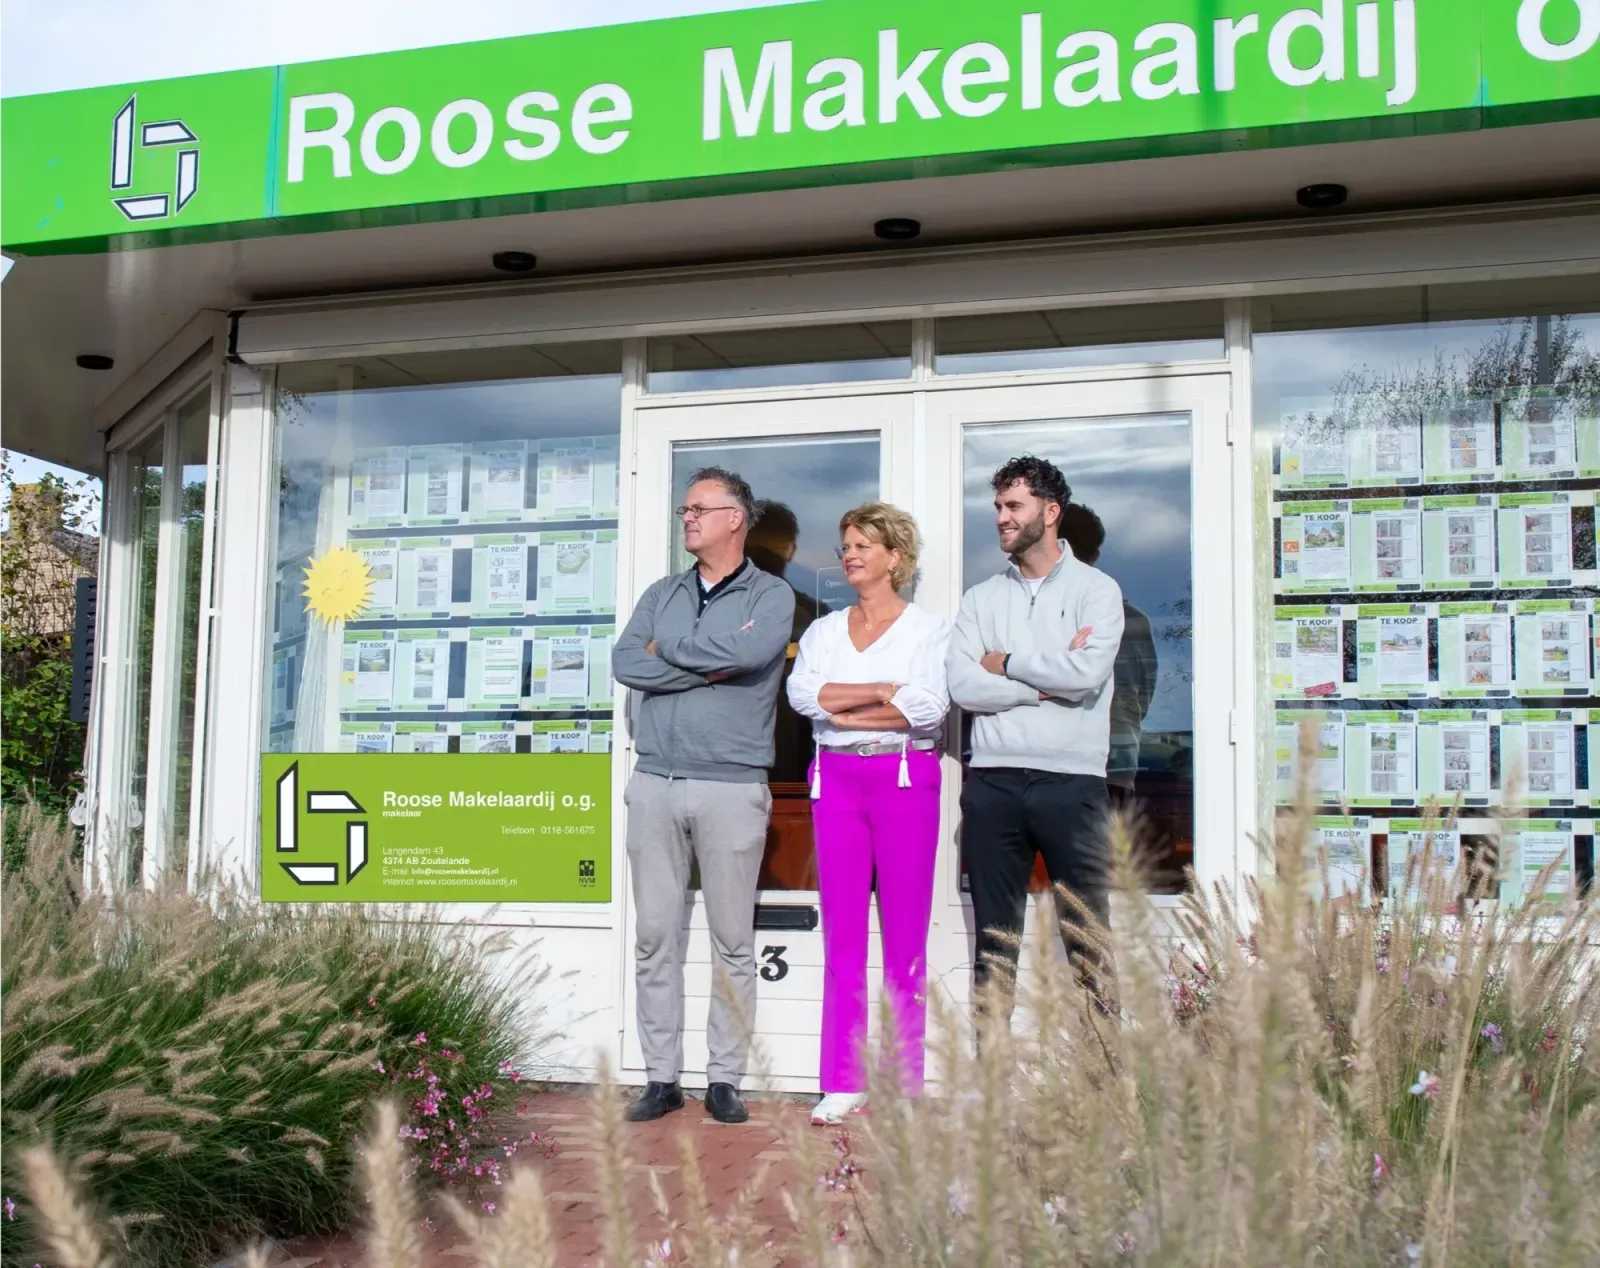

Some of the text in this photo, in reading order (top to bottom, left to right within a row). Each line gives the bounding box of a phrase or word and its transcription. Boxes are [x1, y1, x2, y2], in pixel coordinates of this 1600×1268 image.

[287, 82, 633, 183] Roose
[702, 0, 1418, 141] Makelaardij
[382, 790, 596, 811] Roose Makelaardij o.g.
[382, 809, 422, 818] makelaar
[500, 826, 596, 835] Telefoon 0118-561675
[382, 846, 444, 856] Langendam 43
[382, 857, 470, 865] 4374 AB Zoutelande
[382, 866, 408, 876] E-mail
[382, 878, 415, 886] Internet
[578, 876, 596, 884] NVM
